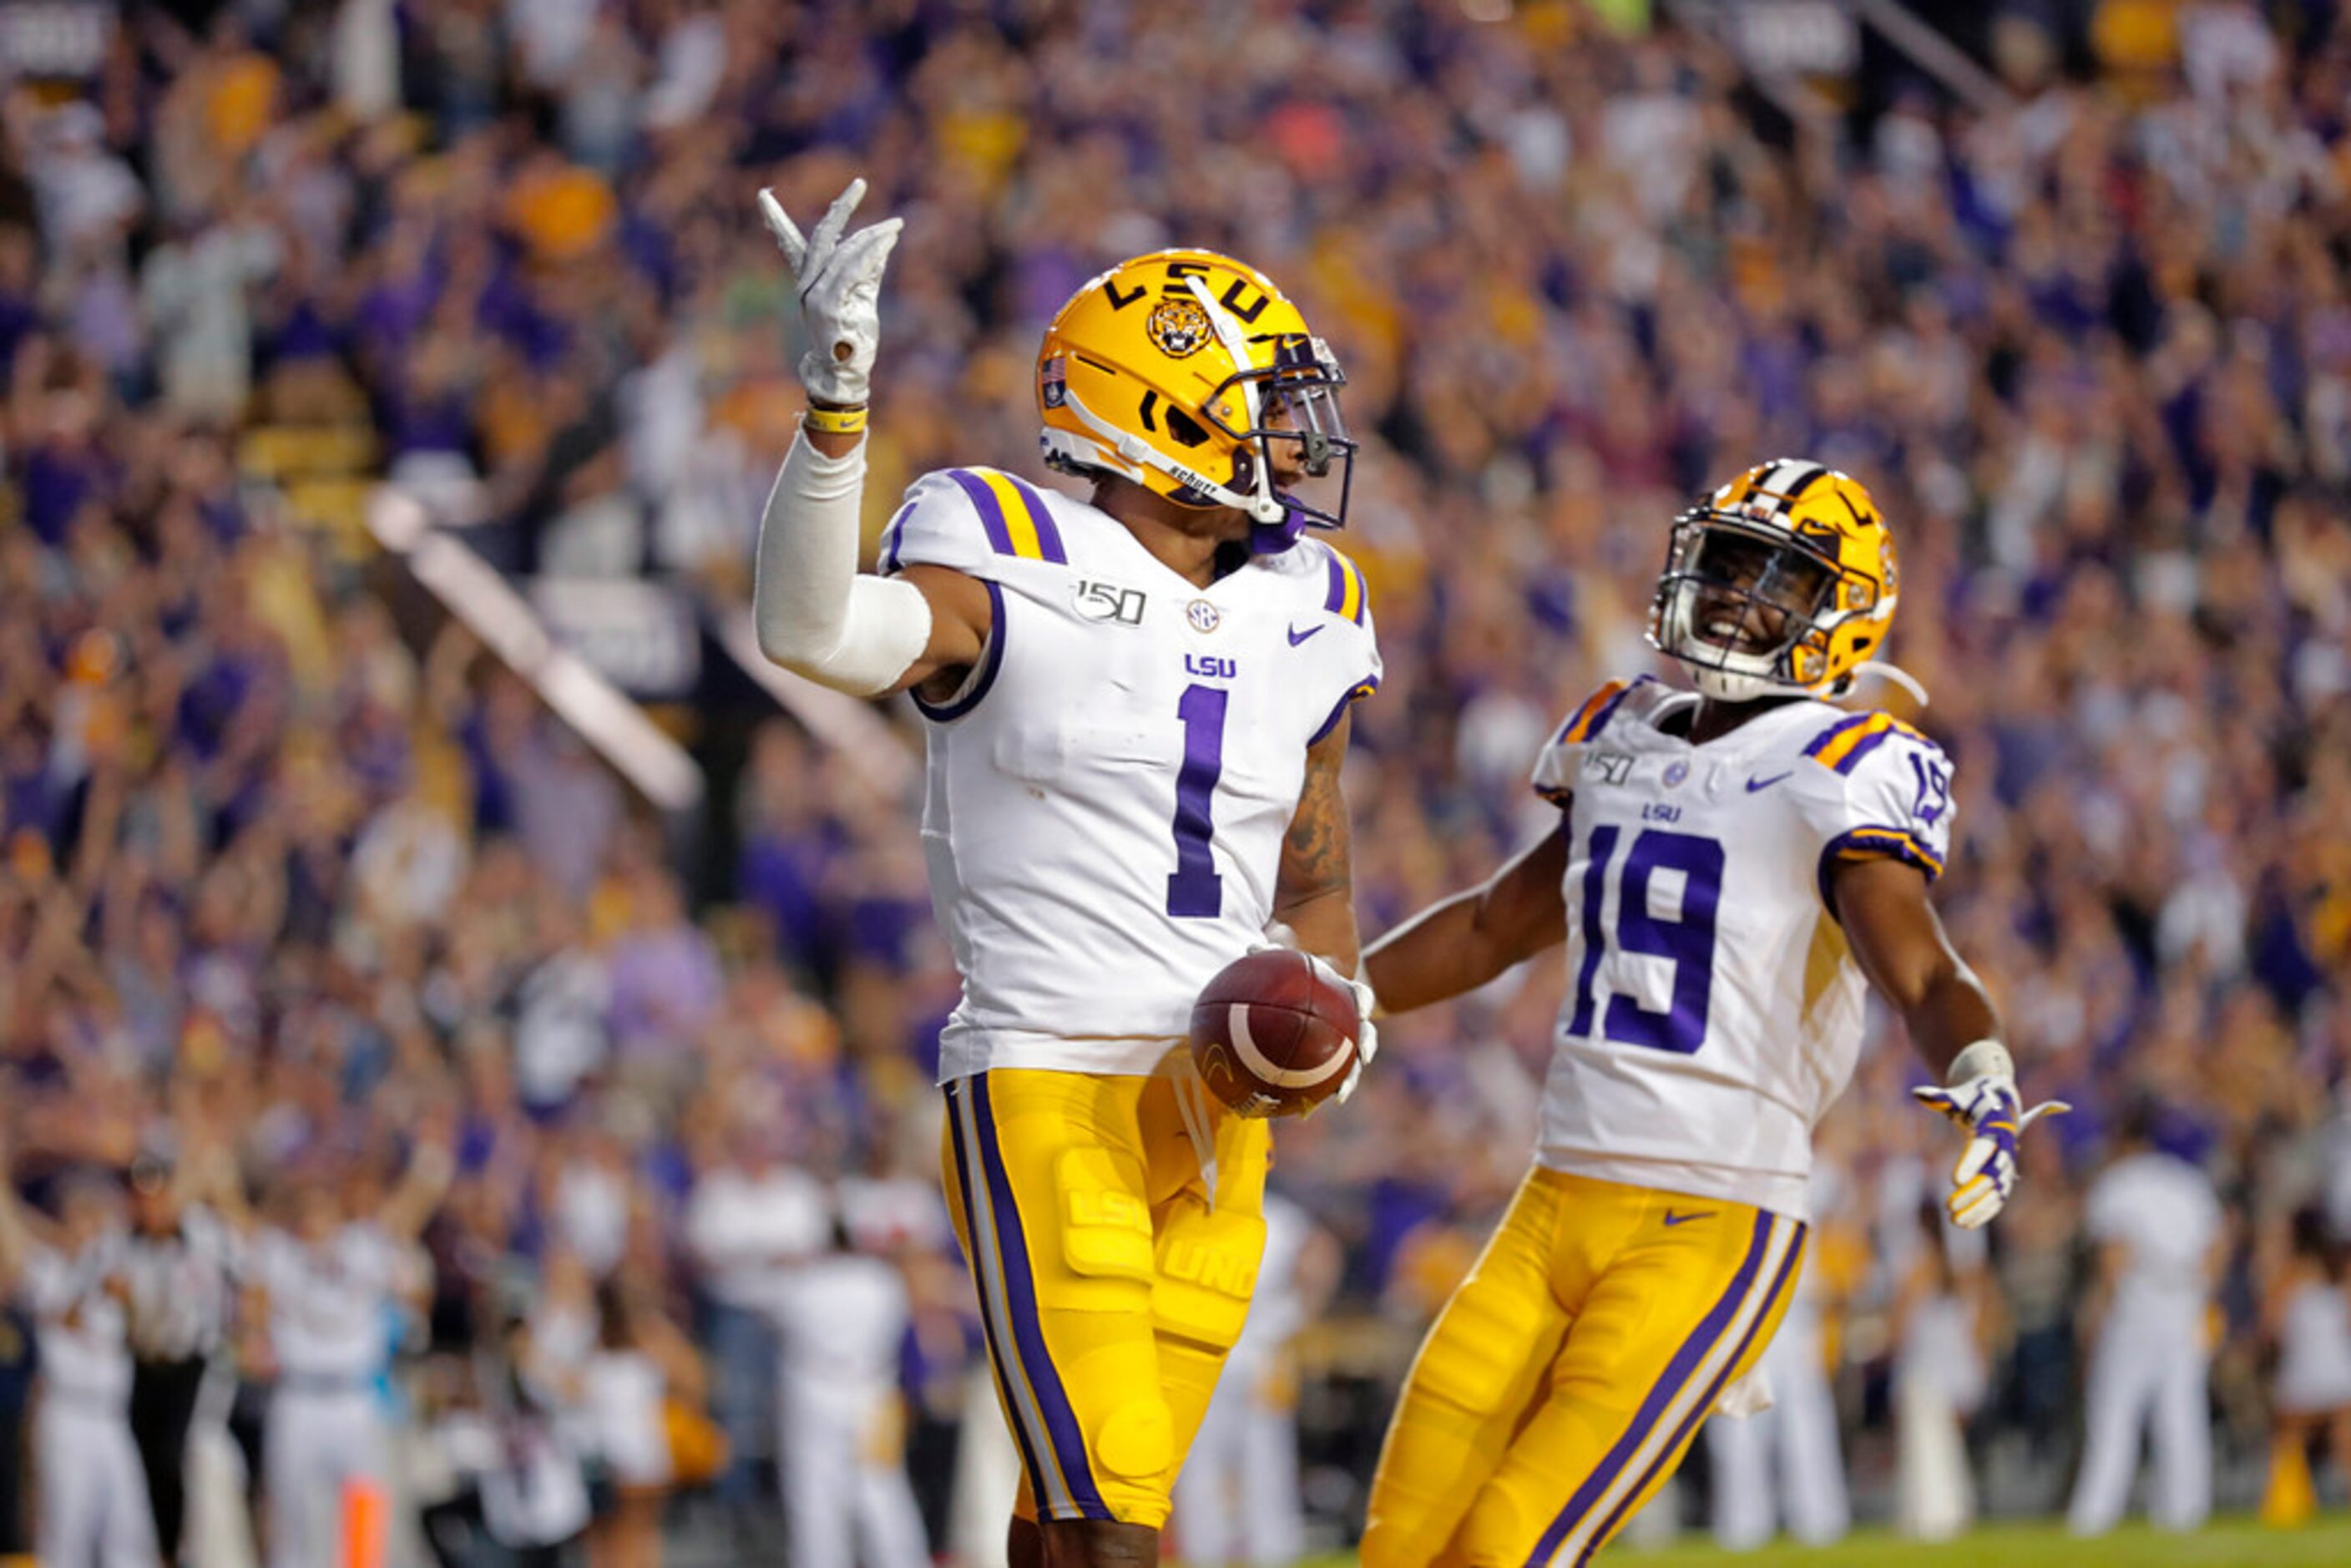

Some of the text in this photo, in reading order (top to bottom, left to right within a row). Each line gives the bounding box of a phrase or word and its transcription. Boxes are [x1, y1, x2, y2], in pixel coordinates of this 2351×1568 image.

[1105, 263, 1269, 323] LSU
[1079, 580, 1146, 625] 150
[1184, 653, 1236, 679] LSU
[1166, 683, 1228, 918] 1
[1641, 802, 1681, 822] LSU
[1566, 824, 1726, 1055] 19
